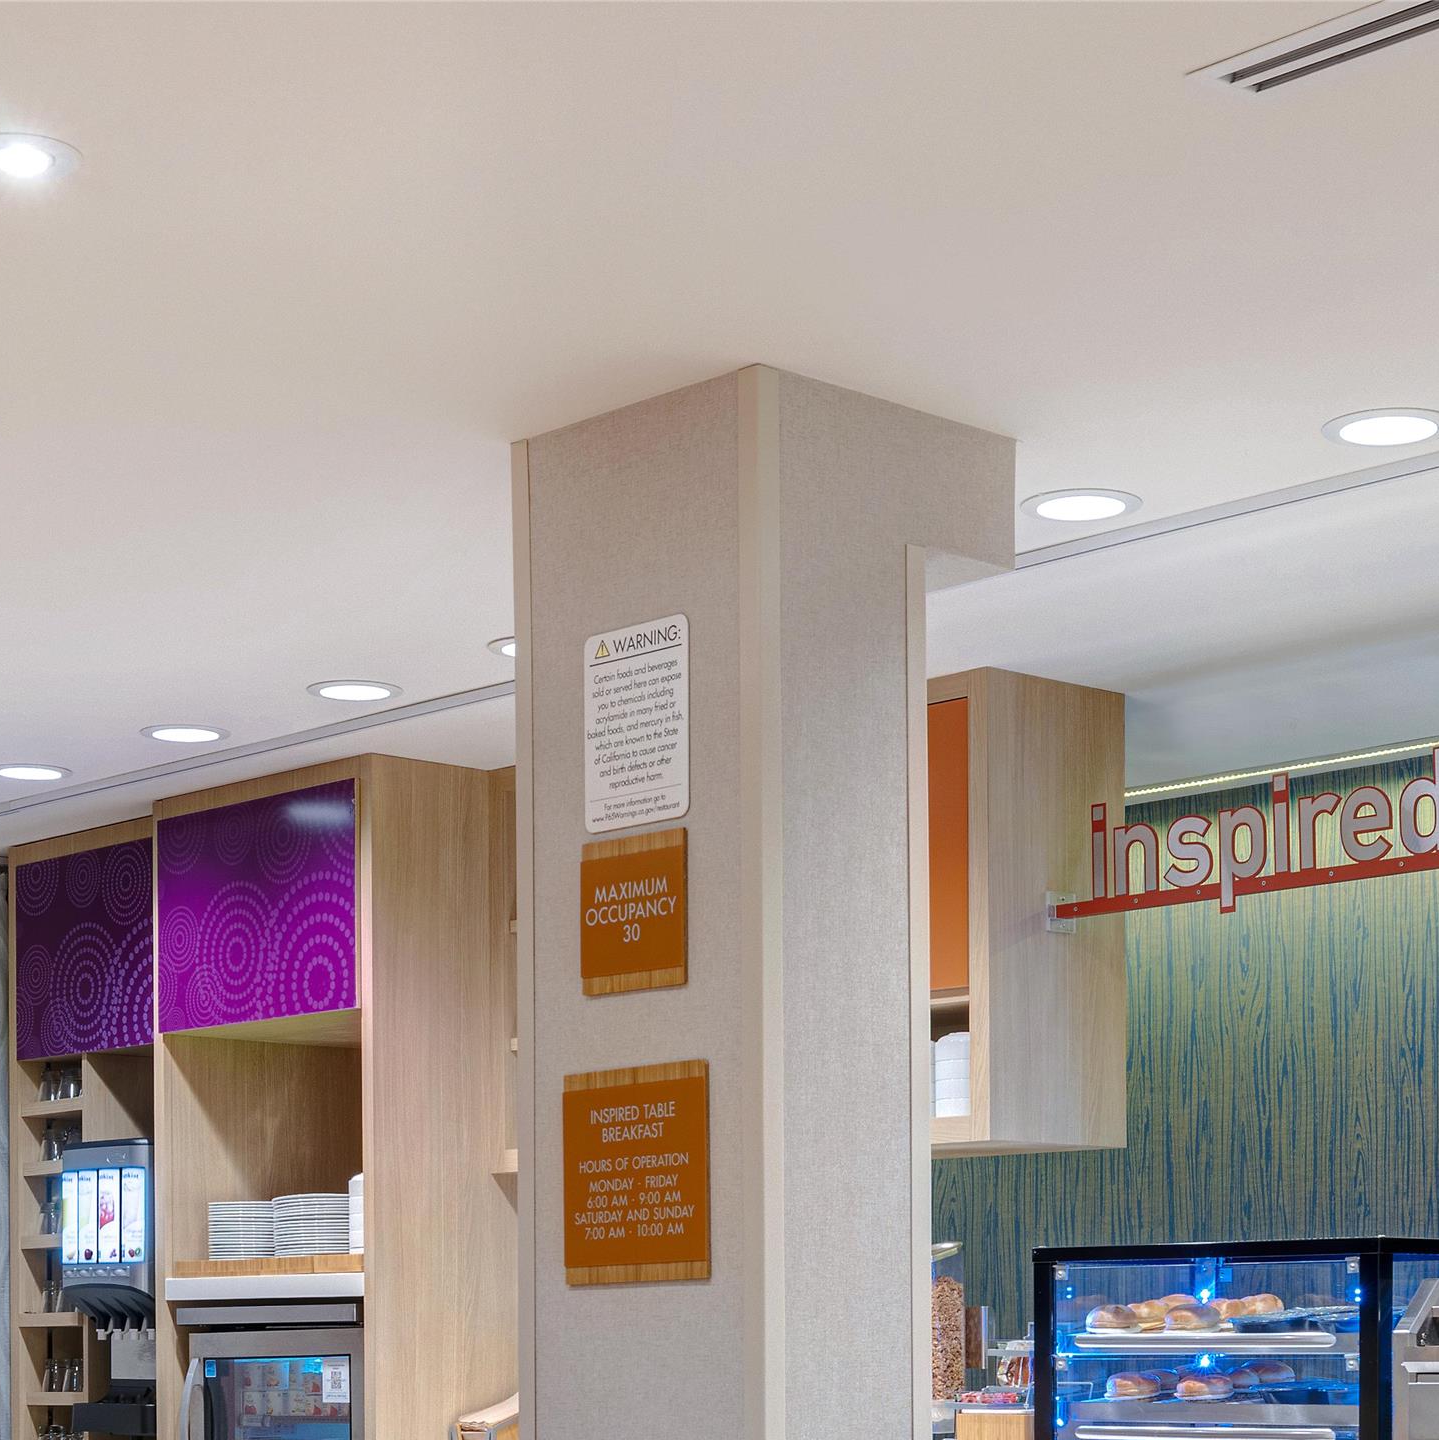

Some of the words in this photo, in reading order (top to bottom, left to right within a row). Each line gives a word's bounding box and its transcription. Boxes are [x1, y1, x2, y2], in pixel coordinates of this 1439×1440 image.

[612, 625, 681, 653] WARNING:
[594, 672, 615, 684] Certain
[617, 666, 633, 679] foods
[634, 663, 647, 675] and
[647, 660, 678, 673] beverages
[592, 687, 604, 698] sold
[605, 688, 612, 696] or
[613, 680, 632, 694] served
[634, 680, 647, 689] here
[648, 677, 660, 686] can
[660, 672, 682, 684] expose
[598, 703, 609, 713] you
[610, 700, 617, 708] to
[617, 691, 646, 706] chemicals
[647, 686, 674, 699] including
[626, 720, 639, 731] and
[594, 754, 601, 765] of
[601, 750, 631, 763] California
[639, 747, 656, 756] cause
[657, 742, 677, 752] cancer
[600, 766, 611, 777] and
[612, 764, 626, 775] birth
[627, 760, 647, 771] defects
[656, 755, 672, 765] other
[594, 876, 668, 904] MAXIMUM
[585, 895, 677, 926] OCCUPANCY
[622, 923, 641, 943] 30
[590, 1105, 640, 1125] INSPIRED
[643, 1101, 676, 1119] TABLE
[602, 1122, 664, 1143] BREAKFAST
[579, 1158, 612, 1173] HOURS
[615, 1157, 629, 1171] OF
[632, 1152, 689, 1170] OPERATION
[589, 1178, 634, 1193] MONDAY
[645, 1174, 679, 1189] FRIDAY
[587, 1195, 608, 1209] 6:00
[611, 1194, 628, 1206] AM
[639, 1191, 660, 1204] 9:00
[664, 1190, 681, 1202] AM
[574, 1210, 623, 1225] SATURDAY
[626, 1208, 650, 1221] AND
[653, 1204, 695, 1220] SUNDAY
[585, 1227, 605, 1240] 7:00
[608, 1227, 625, 1239] AM
[637, 1222, 663, 1237] 10:00
[667, 1222, 684, 1235] AM
